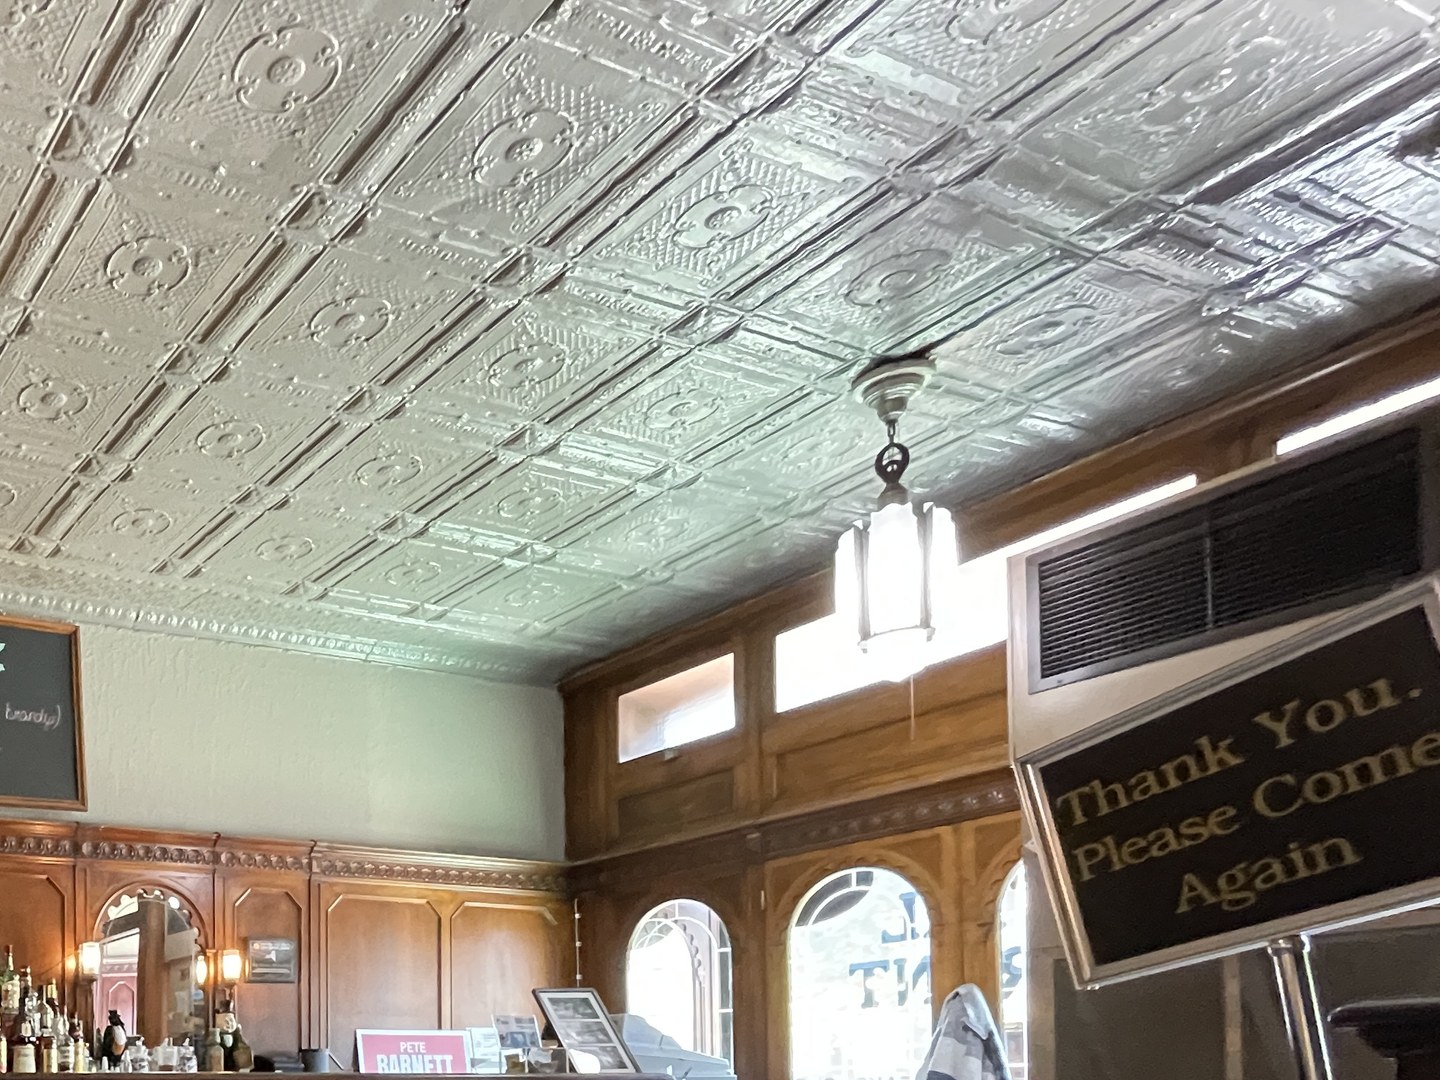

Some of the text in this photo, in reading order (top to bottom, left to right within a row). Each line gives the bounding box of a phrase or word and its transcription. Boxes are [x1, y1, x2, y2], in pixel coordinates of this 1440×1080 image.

[1056, 678, 1423, 826] Thank You.
[1072, 732, 1440, 882] Please Come
[1175, 836, 1364, 914] Again
[376, 1054, 454, 1074] BARNETT
[399, 1041, 427, 1053] PETE
